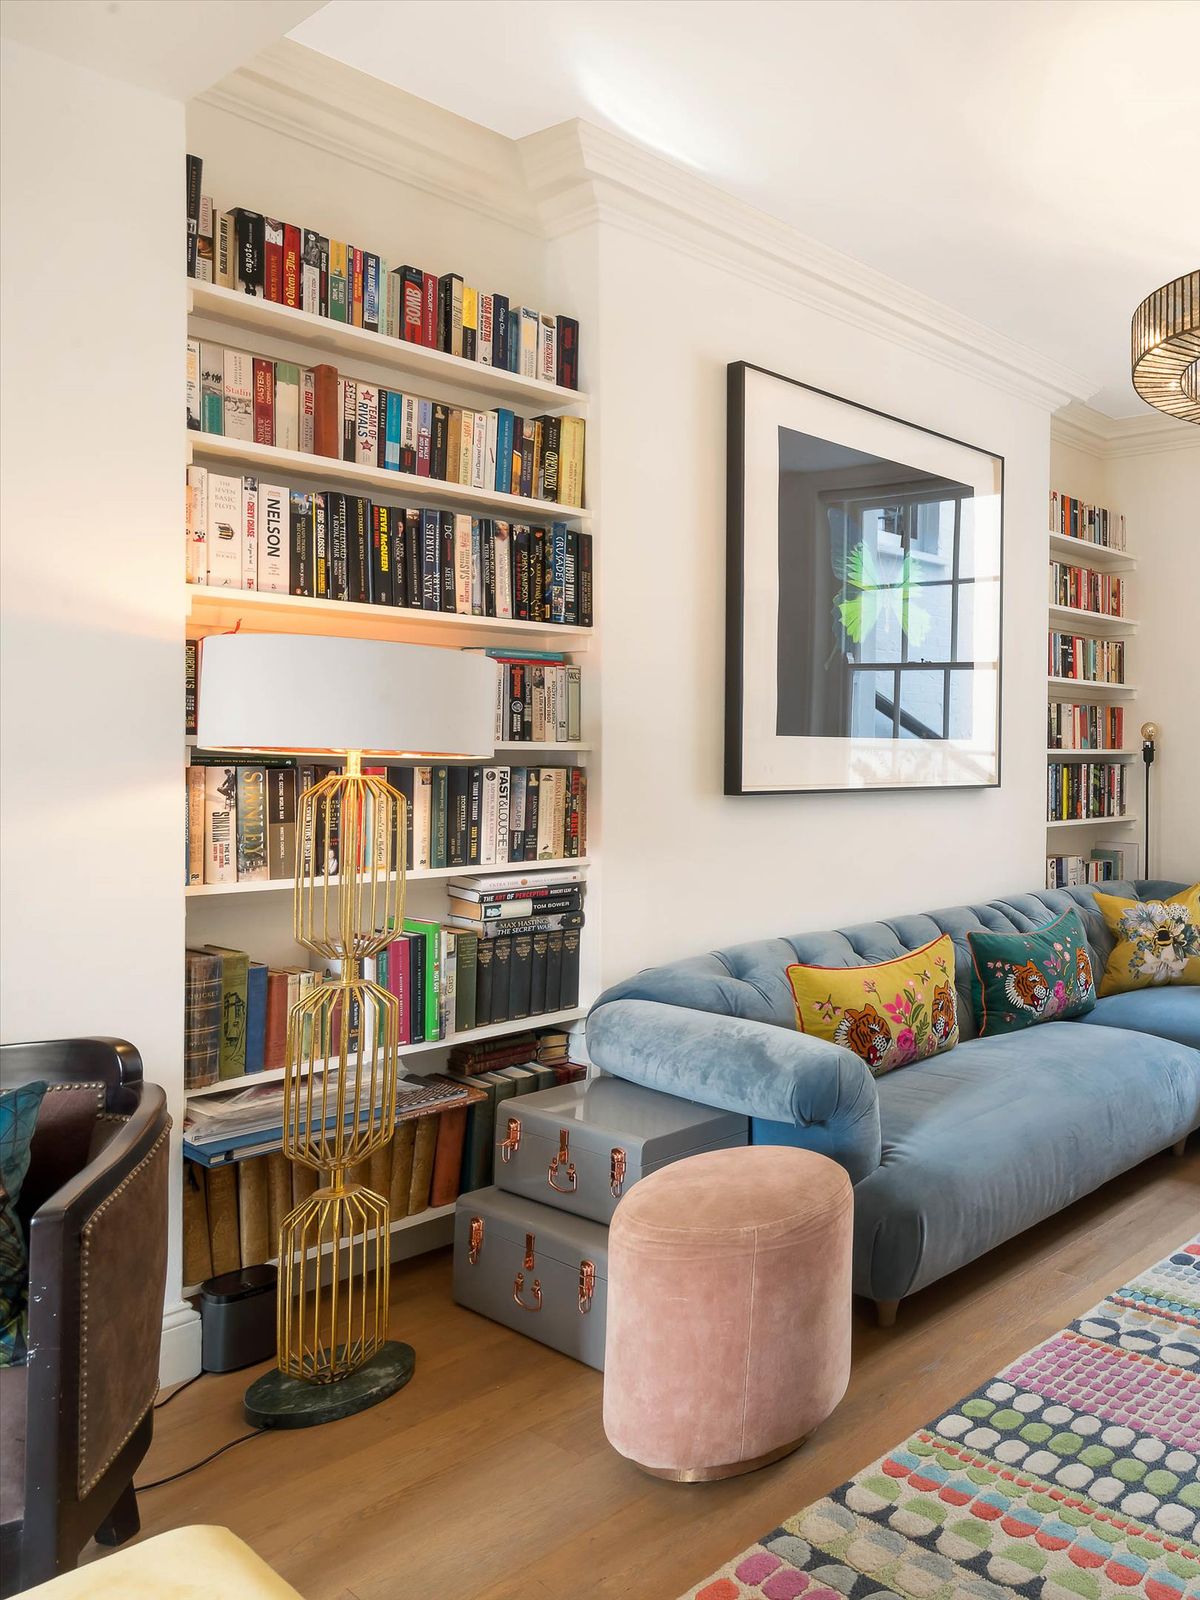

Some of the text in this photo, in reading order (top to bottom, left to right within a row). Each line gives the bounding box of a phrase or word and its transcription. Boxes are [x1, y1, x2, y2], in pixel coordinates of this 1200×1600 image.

[243, 243, 254, 274] capote
[285, 251, 295, 270] Man
[368, 257, 376, 267] THE
[405, 288, 422, 326] BOMB
[483, 295, 492, 343] COSA NOSTRA
[545, 329, 554, 344] THE
[545, 342, 554, 374] GENERAL
[225, 384, 251, 397] Stalin
[257, 370, 265, 403] MASTERS
[304, 390, 313, 416] GULAG
[344, 381, 356, 421] ESCOBAR
[358, 401, 368, 438] RIVALS
[368, 405, 377, 441] TEAM OF
[544, 451, 558, 490] STALINGRAD
[247, 501, 255, 538] CHEVY CHASE
[267, 498, 281, 558] NELSON
[444, 525, 452, 540] DC
[317, 523, 325, 558] SCHLOSSER
[380, 507, 389, 571] STEVE McQUEEN
[425, 523, 434, 562] DIARIES
[459, 564, 470, 580] SAS
[555, 536, 564, 581] CRUSADES
[424, 574, 432, 599] ALAN
[521, 550, 529, 603] JOHN SIMPSON
[186, 646, 195, 689] CHURCHILL'S
[499, 770, 509, 801] FAST
[212, 811, 230, 843] SINATRA
[241, 771, 264, 857] STANLEY
[498, 808, 508, 847] LOUCHE
[570, 812, 579, 838] ANGEL
[515, 889, 549, 899] PERCEPTION
[512, 925, 536, 934] SECRET
[518, 918, 549, 927] HASTINGS
